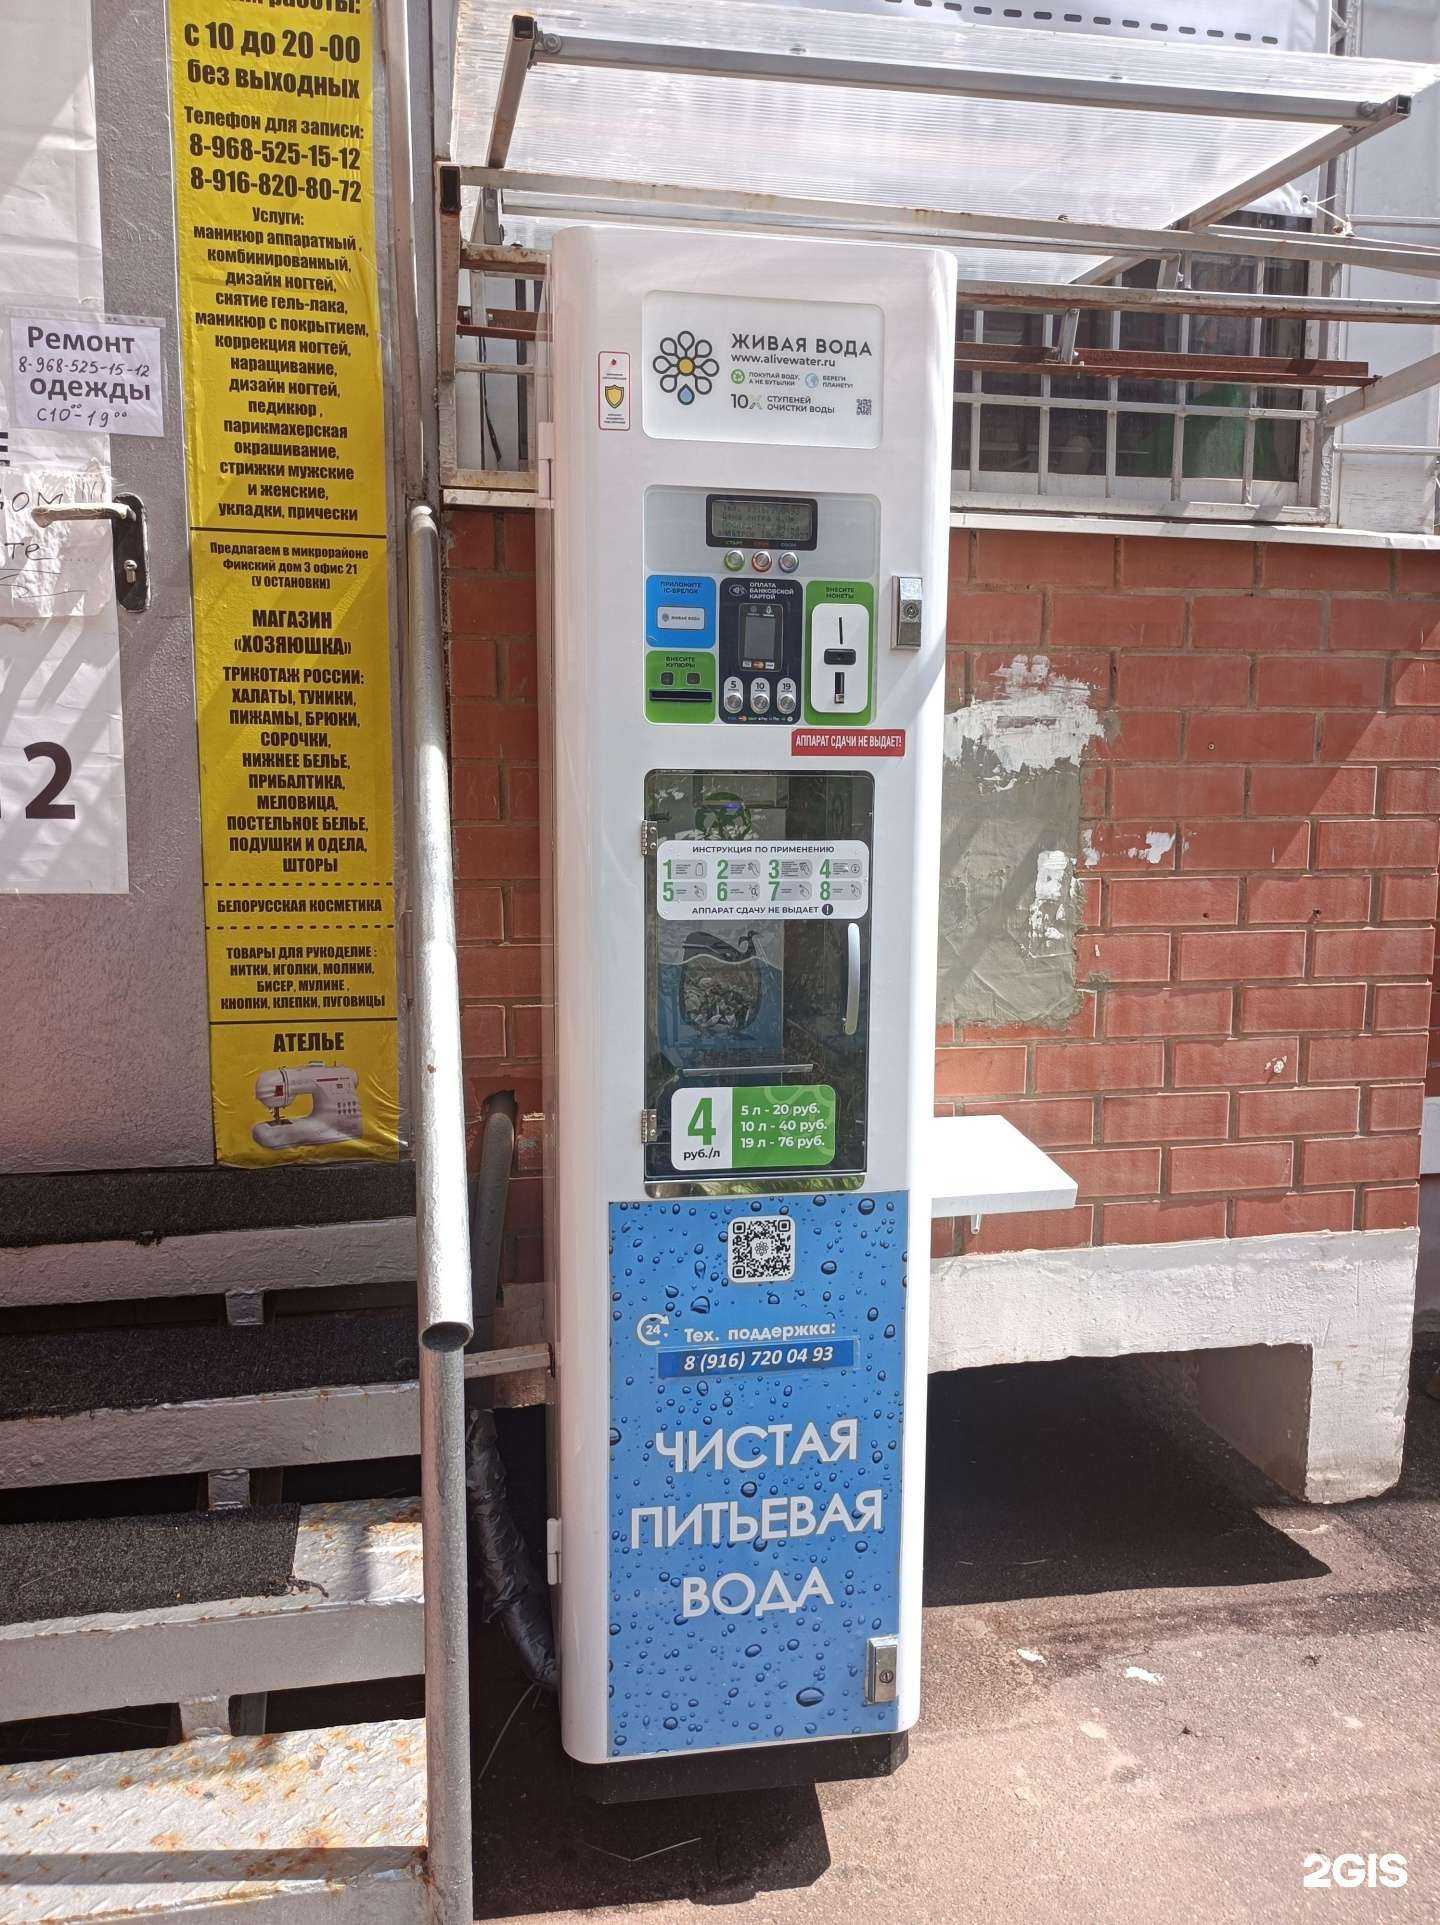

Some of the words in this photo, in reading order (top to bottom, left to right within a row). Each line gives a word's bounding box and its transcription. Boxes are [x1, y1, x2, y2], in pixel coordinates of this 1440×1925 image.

[184, 23, 200, 47] с
[205, 21, 234, 51] 10
[241, 30, 276, 57] до
[187, 60, 230, 85] без
[236, 67, 361, 99] выходных
[184, 105, 261, 131] Телефон
[264, 115, 297, 134] для
[300, 119, 365, 140] записи:
[189, 133, 361, 170] 8-968-525-15-12
[190, 166, 362, 203] 8-916-820-80-72
[252, 206, 304, 226] Услуги:
[193, 226, 264, 244] маникюр
[207, 248, 352, 272] комбинированный,
[225, 272, 282, 287] дизайн
[285, 276, 337, 293] ногтей,
[215, 292, 268, 308] снятие
[195, 312, 265, 330] маникюр
[269, 317, 277, 329] с
[27, 326, 135, 354] Ремонт
[215, 334, 296, 353] коррекция
[300, 339, 352, 357] ногтей,
[731, 332, 807, 353] ЖИВАЯ
[816, 338, 873, 358] ВОДА
[231, 356, 338, 376] наращивание,
[730, 353, 836, 368] www.alivewater.ru
[29, 377, 150, 404] одежды
[229, 377, 285, 394] дизайн
[288, 381, 341, 398] ногтей,
[767, 395, 811, 404] СТУПЕНЕЙ
[767, 404, 807, 413] ОЧИСТКИ
[809, 405, 835, 415] ВОДЫ
[223, 420, 348, 439] парикмахерская
[234, 441, 340, 460] окрашивание,
[219, 461, 285, 477] стрижки
[288, 465, 355, 480] мужские
[248, 483, 257, 496] и
[260, 483, 329, 501] женские,
[288, 505, 358, 522] прически
[210, 542, 280, 556] Предлагаем
[283, 547, 289, 556] в
[292, 547, 369, 560] микрорайоне
[223, 558, 276, 572] Финский
[278, 562, 301, 574] дом
[304, 561, 311, 573] 3
[313, 563, 344, 575] офис
[346, 563, 358, 575] 21
[252, 609, 332, 629] МАГАЗИН
[234, 635, 352, 655] «ХОЗЯЮШКА»
[223, 666, 300, 683] ТРИКОТАЖ
[303, 668, 364, 685] РОССИИ:
[730, 681, 737, 689] 5
[755, 682, 765, 690] 10
[232, 688, 296, 706] ХАЛАТЫ,
[300, 689, 357, 707] ТУНИКИ,
[229, 710, 302, 727] ПИЖАМЫ,
[305, 711, 361, 728] БРЮКИ,
[260, 731, 331, 748] СОРОЧКИ,
[796, 735, 829, 748] АППАРАТ
[830, 736, 857, 749] СДАЧИ
[859, 736, 868, 748] НЕ
[869, 736, 902, 748] ВЫДАЕТ!
[242, 752, 300, 768] НИЖНЕЕ
[303, 753, 351, 770] БЕЛЬЕ,
[249, 773, 346, 791] ПРИБАЛТИКА,
[257, 795, 339, 811] МЕЛОВИЦА,
[227, 815, 319, 831] ПОСТЕЛЬНОЕ
[322, 816, 369, 832] БЕЛЬЕ,
[229, 837, 301, 853] ПОДУШКИ
[306, 838, 315, 851] И
[318, 837, 368, 853] ОДЕЛА,
[692, 846, 752, 854] ИНСТРУКЦИЯ
[283, 858, 338, 873] ШТОРЫ
[662, 859, 672, 879] 1
[717, 859, 728, 879] 2
[768, 859, 779, 879] 3
[820, 859, 831, 878] 4
[663, 881, 674, 902] 5
[717, 881, 728, 901] 6
[768, 881, 780, 901] 7
[820, 881, 831, 901] 8
[217, 899, 306, 913] БЕЛОРУССКАЯ
[309, 899, 382, 912] КОСМЕТИКА
[692, 906, 734, 915] АППАРАТ
[736, 906, 765, 915] СДАЧУ
[768, 906, 780, 914] НЕ
[782, 906, 819, 915] ВЫДАЕТ
[226, 947, 276, 959] ТОВАРЫ
[278, 947, 303, 960] ДЛЯ
[220, 998, 270, 1011] КНОПКИ,
[323, 996, 386, 1009] ПУГОВИЦЫ
[273, 1032, 345, 1053] АТЕЛЬЕ
[741, 1105, 750, 1116] 5
[752, 1107, 761, 1115] л
[773, 1104, 789, 1115] 20
[793, 1103, 820, 1117] руб.
[687, 1097, 717, 1146] 4
[741, 1121, 754, 1132] 10
[758, 1123, 767, 1132] л
[778, 1120, 797, 1131] 40
[800, 1119, 827, 1134] руб.
[741, 1137, 754, 1149] 19
[757, 1139, 766, 1148] л
[778, 1136, 795, 1147] 76
[798, 1135, 825, 1150] руб.
[683, 1148, 720, 1161] руб./л
[684, 1328, 719, 1343] Тех.
[728, 1322, 837, 1341] поддержка:
[684, 1355, 695, 1371] 8
[700, 1351, 745, 1373] (916)
[751, 1349, 782, 1366] 720
[786, 1348, 808, 1363] 04
[812, 1346, 834, 1362] 93
[654, 1418, 859, 1474] ЧИСТАЯ
[630, 1489, 883, 1550] ПИТЬЕВАЯ
[682, 1566, 834, 1619] ВОДА
